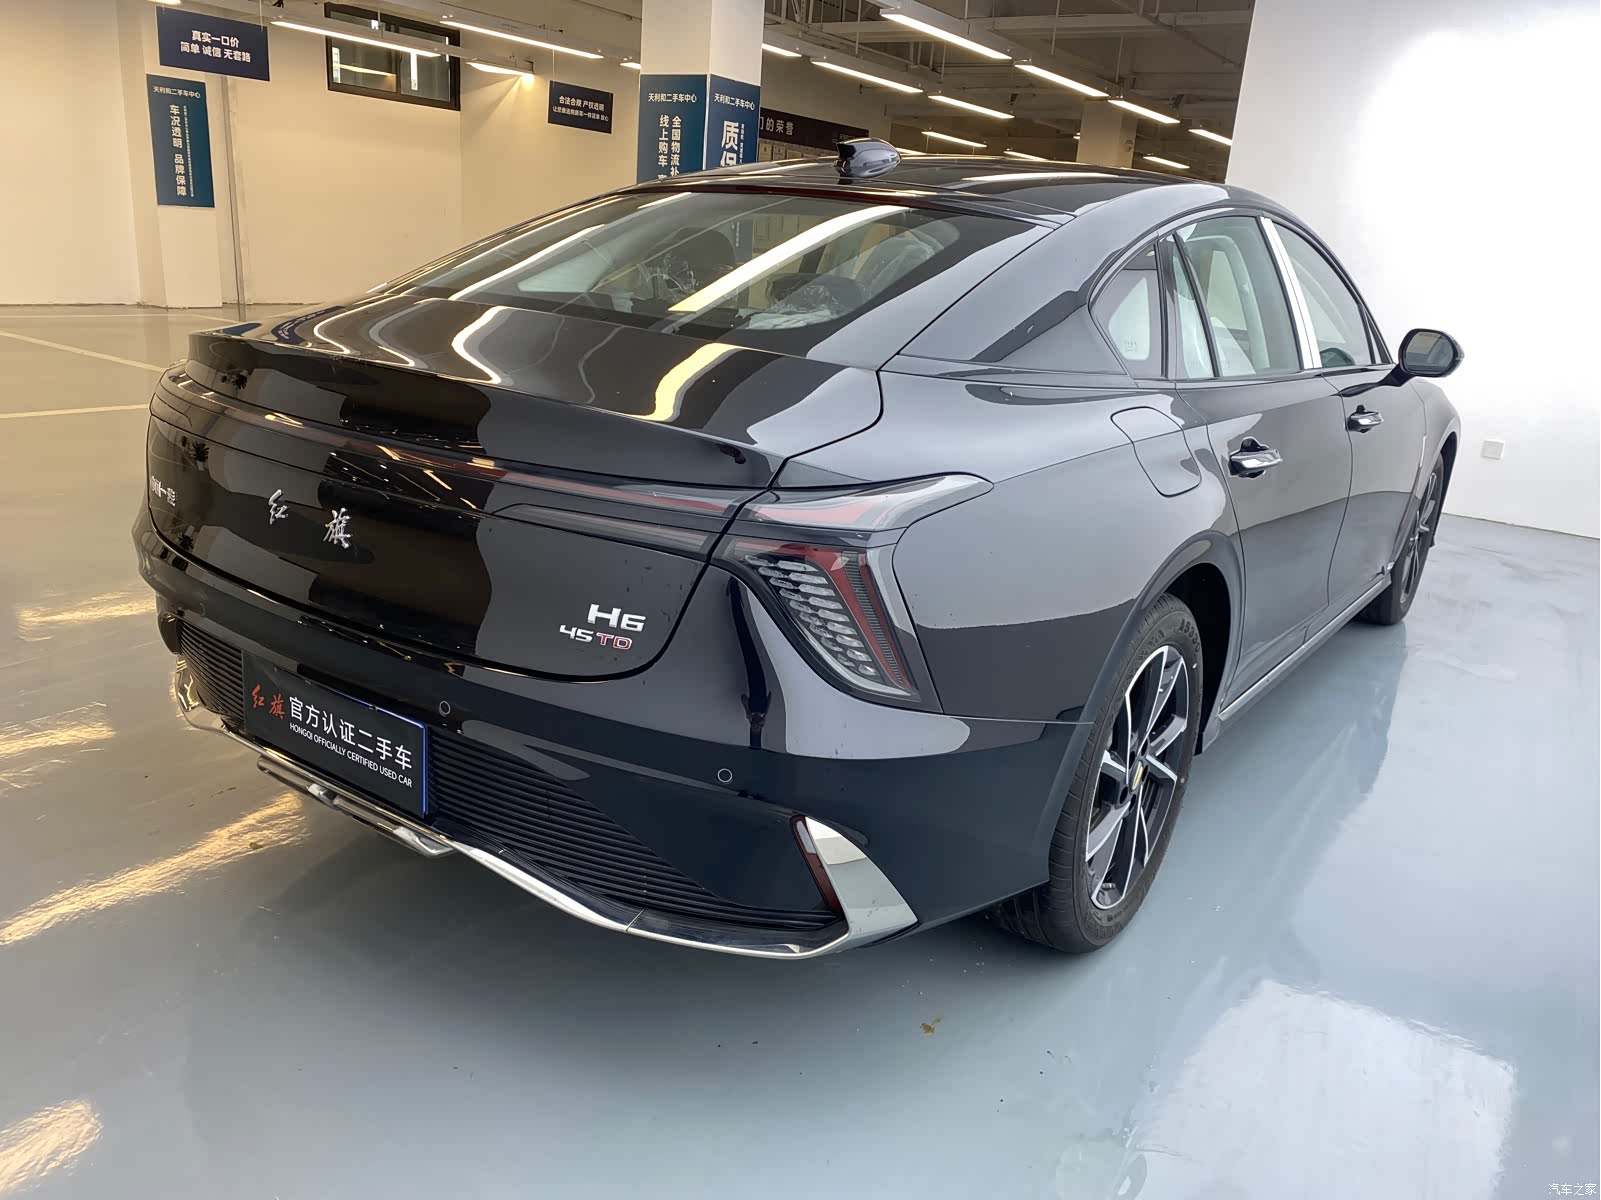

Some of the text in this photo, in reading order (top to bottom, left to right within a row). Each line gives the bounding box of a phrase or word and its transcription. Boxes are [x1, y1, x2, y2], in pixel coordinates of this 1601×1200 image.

[180, 41, 251, 63] 简单 诚信 无套路
[191, 30, 239, 48] 真实一口价
[153, 85, 200, 99] 天利和二手车中心
[559, 95, 605, 112] 合法合规 产权透明
[648, 93, 697, 103] 天利和二手车中心
[714, 93, 755, 111] 天利和二手车中心
[657, 115, 669, 167] 线上购车
[268, 489, 351, 549] 红旗
[587, 603, 646, 632] H6
[559, 624, 633, 650] 45TD
[252, 684, 286, 721] 红旗
[289, 696, 413, 771] 官方认证二手车
[289, 722, 413, 788] HONGQI OFFICIALLY CERTIFIED USED CAR
